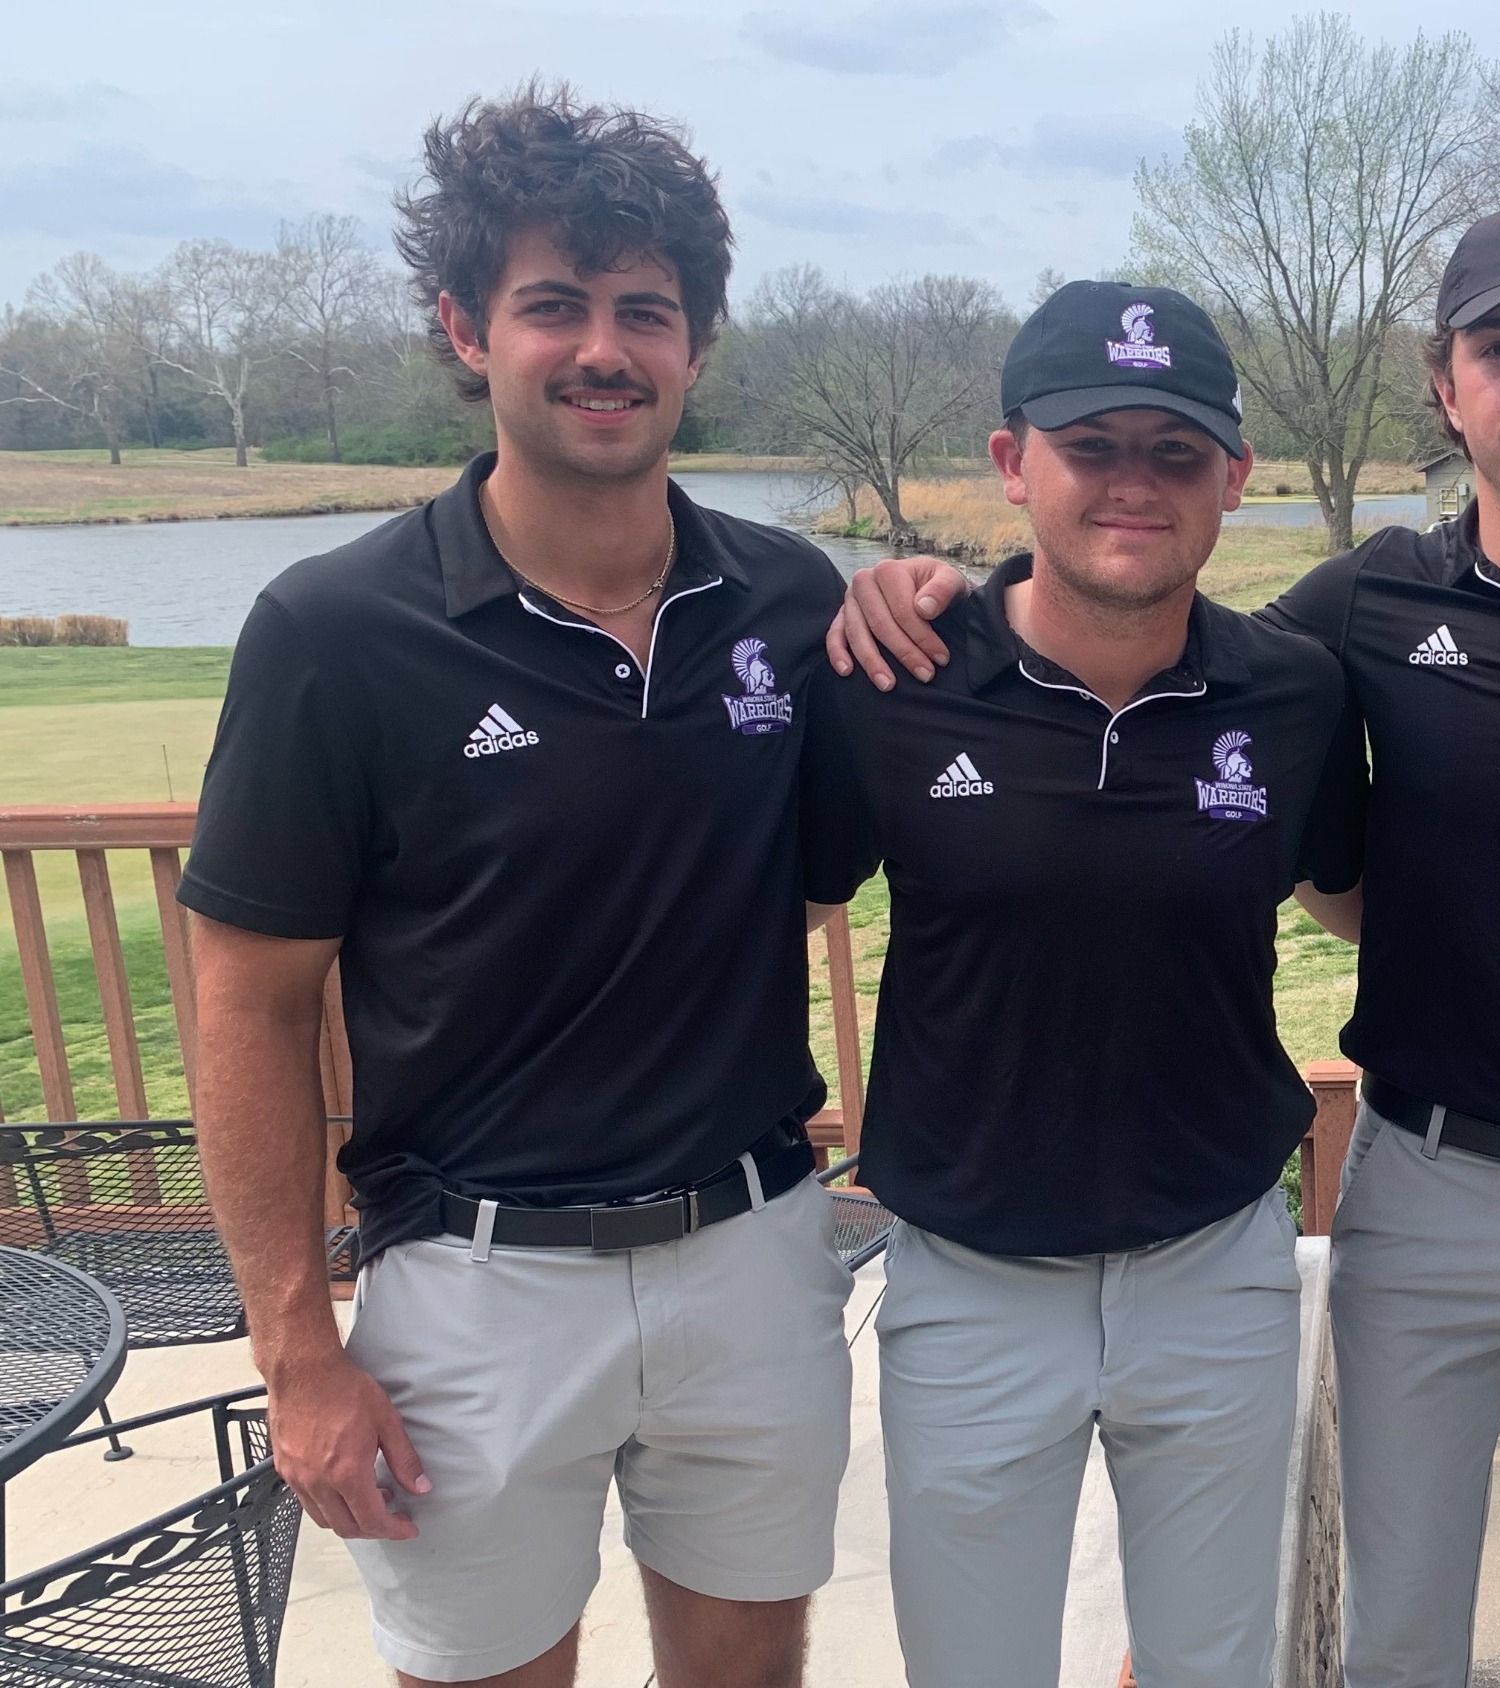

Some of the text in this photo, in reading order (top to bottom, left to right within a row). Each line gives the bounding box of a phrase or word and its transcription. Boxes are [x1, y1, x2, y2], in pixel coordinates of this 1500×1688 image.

[1107, 341, 1171, 367] WARRIORS
[1409, 649, 1469, 666] adidas
[723, 693, 792, 729] WARRIORS
[756, 724, 772, 732] GOLF
[464, 730, 540, 758] adidas
[929, 779, 994, 798] adidas
[1196, 780, 1267, 815] WARRIORS
[1225, 810, 1242, 819] GOLF
